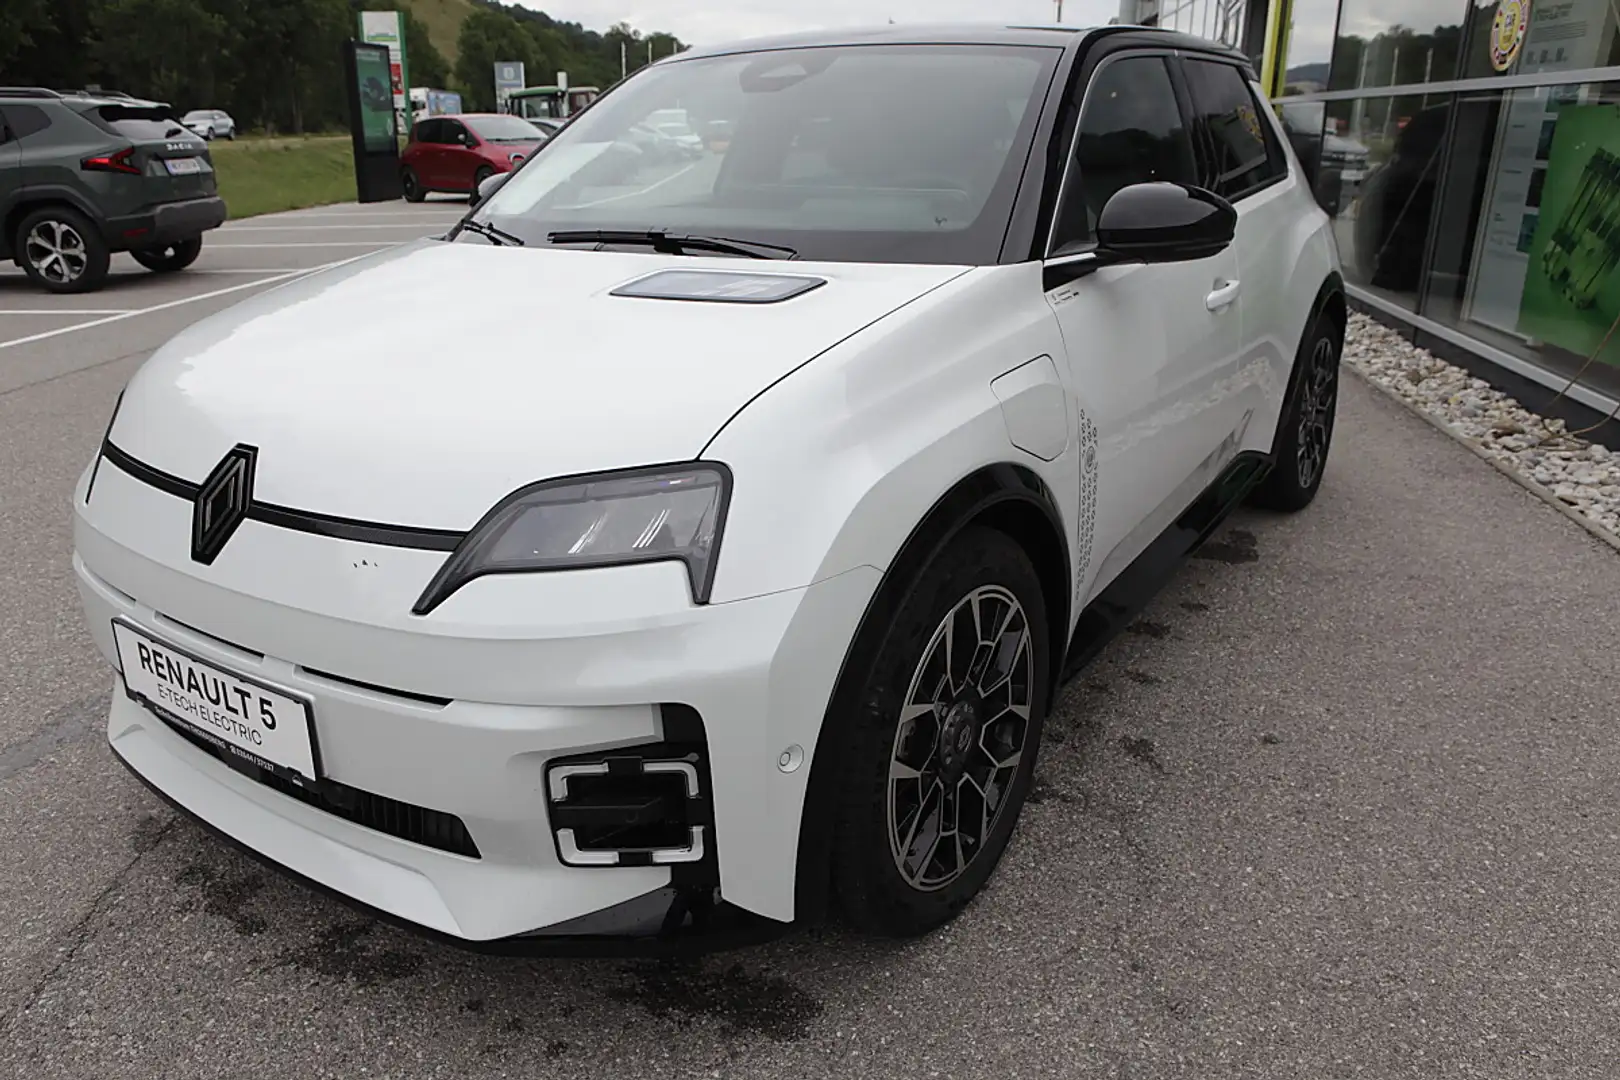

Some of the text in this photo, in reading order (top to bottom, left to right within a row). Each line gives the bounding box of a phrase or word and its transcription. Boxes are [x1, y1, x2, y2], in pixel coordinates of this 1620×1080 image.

[137, 642, 251, 719] RENAULT
[259, 697, 277, 730] 5
[157, 683, 199, 716] E-TECH
[200, 705, 262, 745] ELECTRIC
